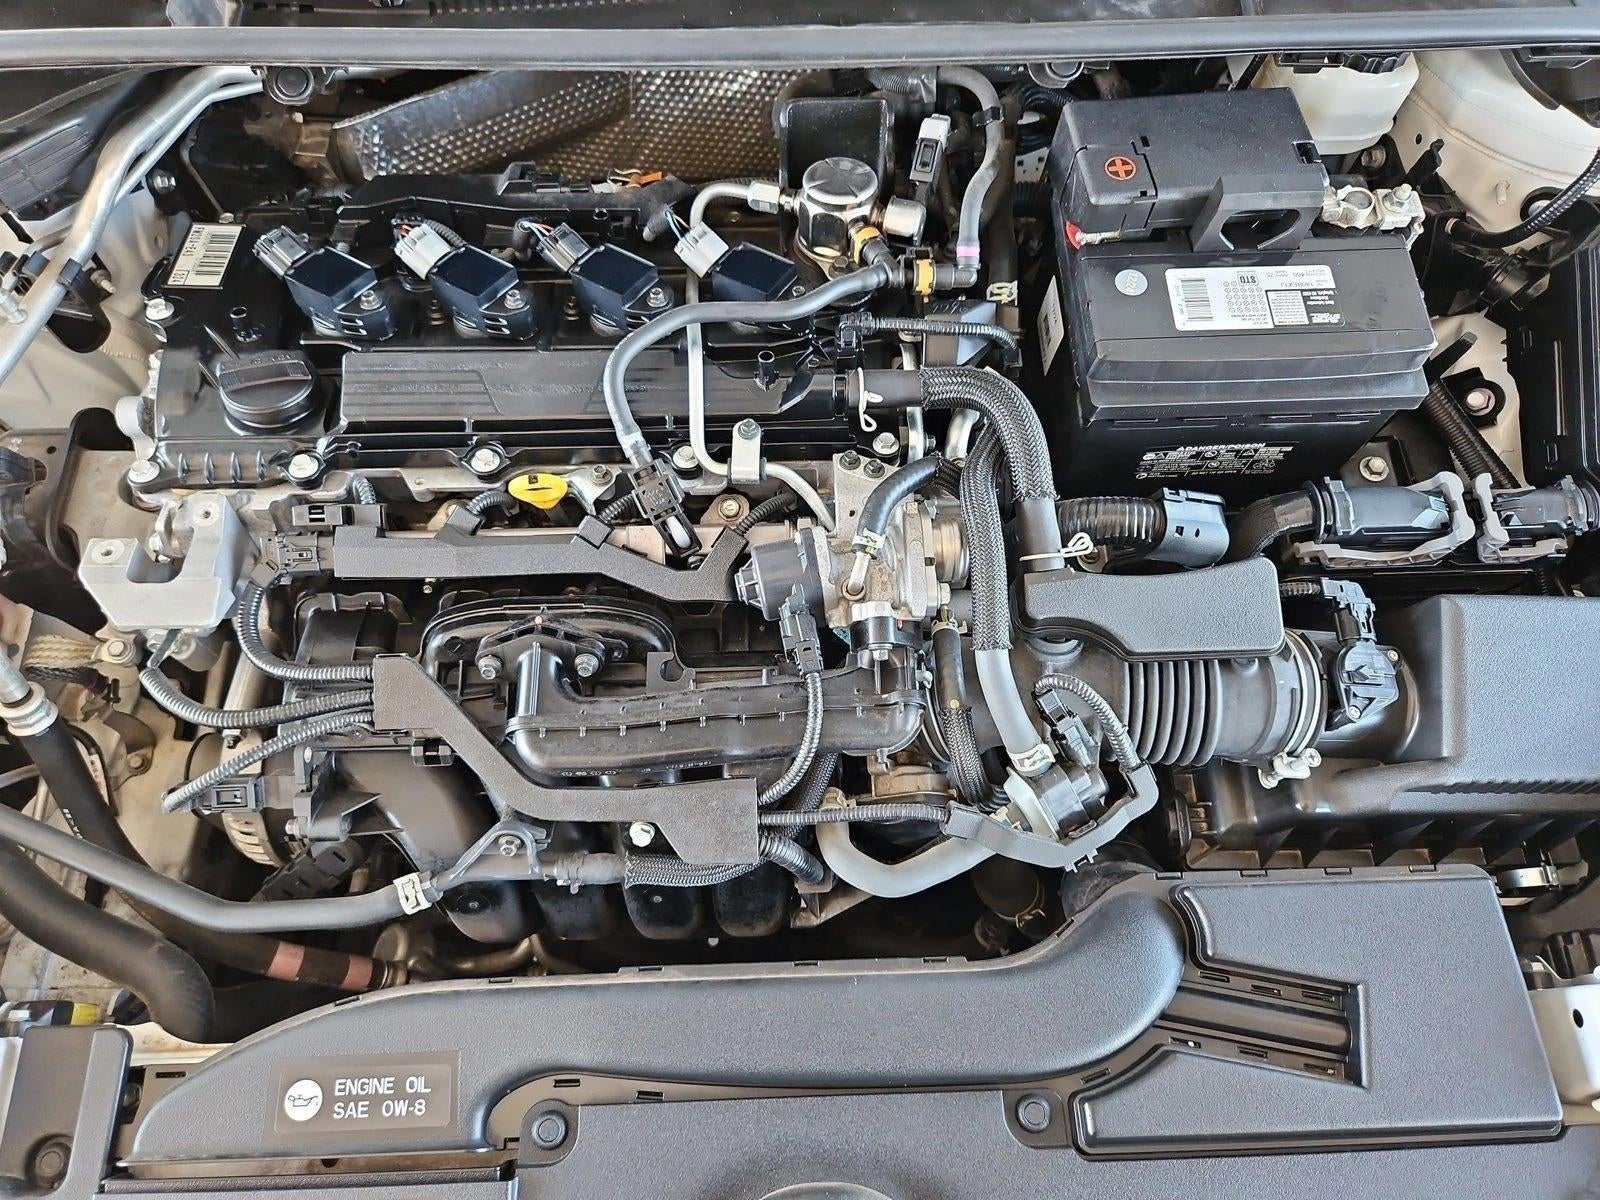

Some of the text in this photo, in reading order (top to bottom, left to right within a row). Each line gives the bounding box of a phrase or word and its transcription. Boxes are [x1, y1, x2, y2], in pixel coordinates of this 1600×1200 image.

[1239, 275, 1257, 284] STD
[335, 1076, 432, 1096] ENGINE OIL
[333, 1101, 370, 1119] SAE
